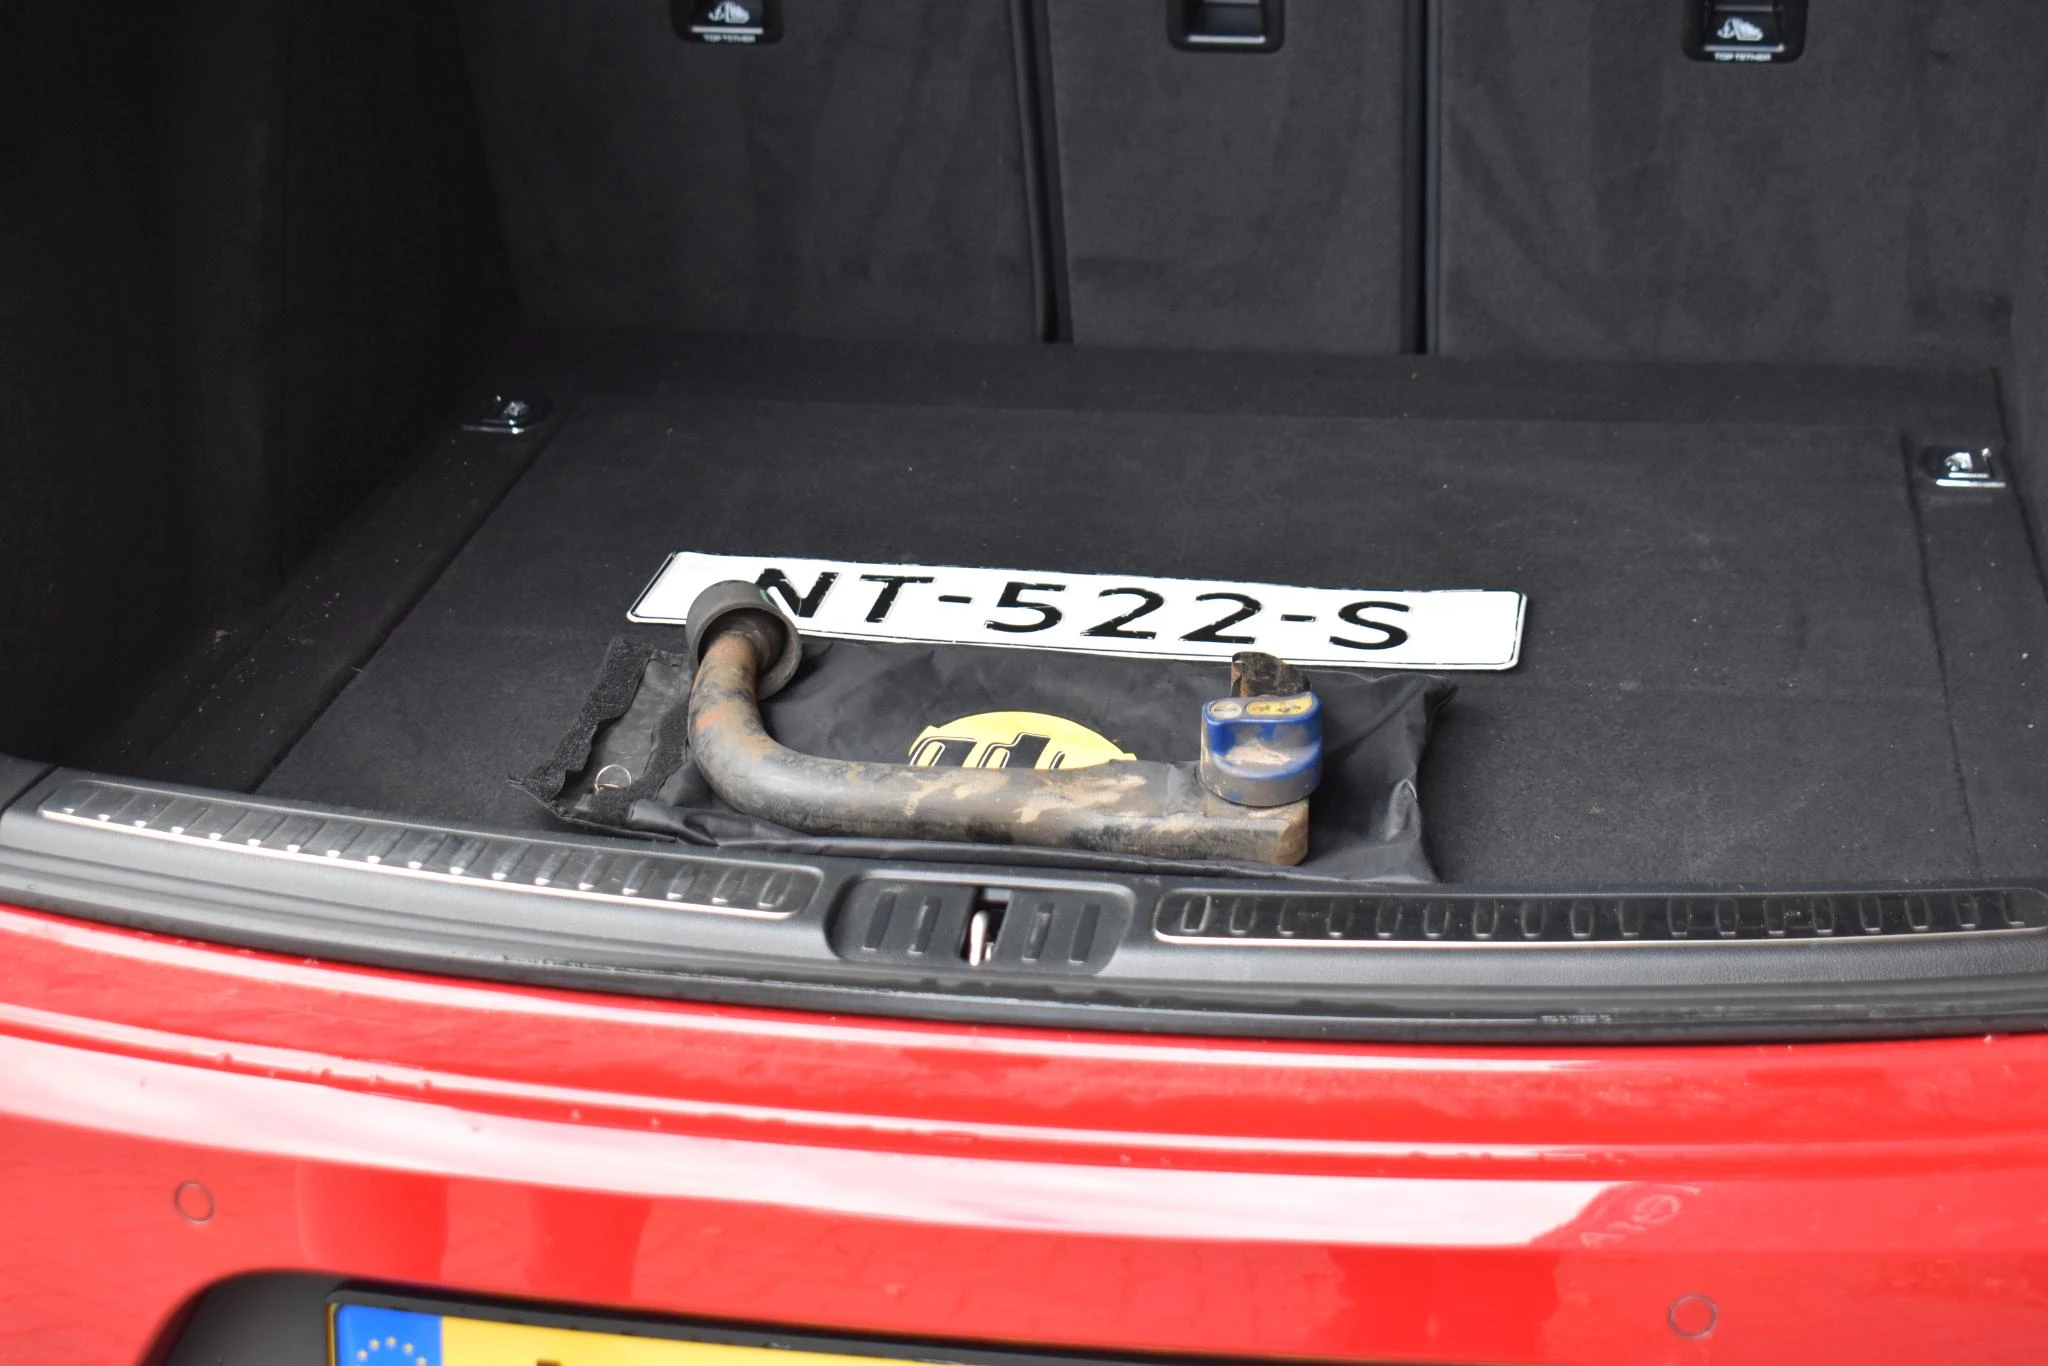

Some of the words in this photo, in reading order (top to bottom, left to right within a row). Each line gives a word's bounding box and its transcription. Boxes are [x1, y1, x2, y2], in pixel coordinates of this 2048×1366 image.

[1714, 52, 1733, 61] TOP
[1735, 52, 1772, 61] TETHER
[755, 567, 1411, 650] NT-522-S
